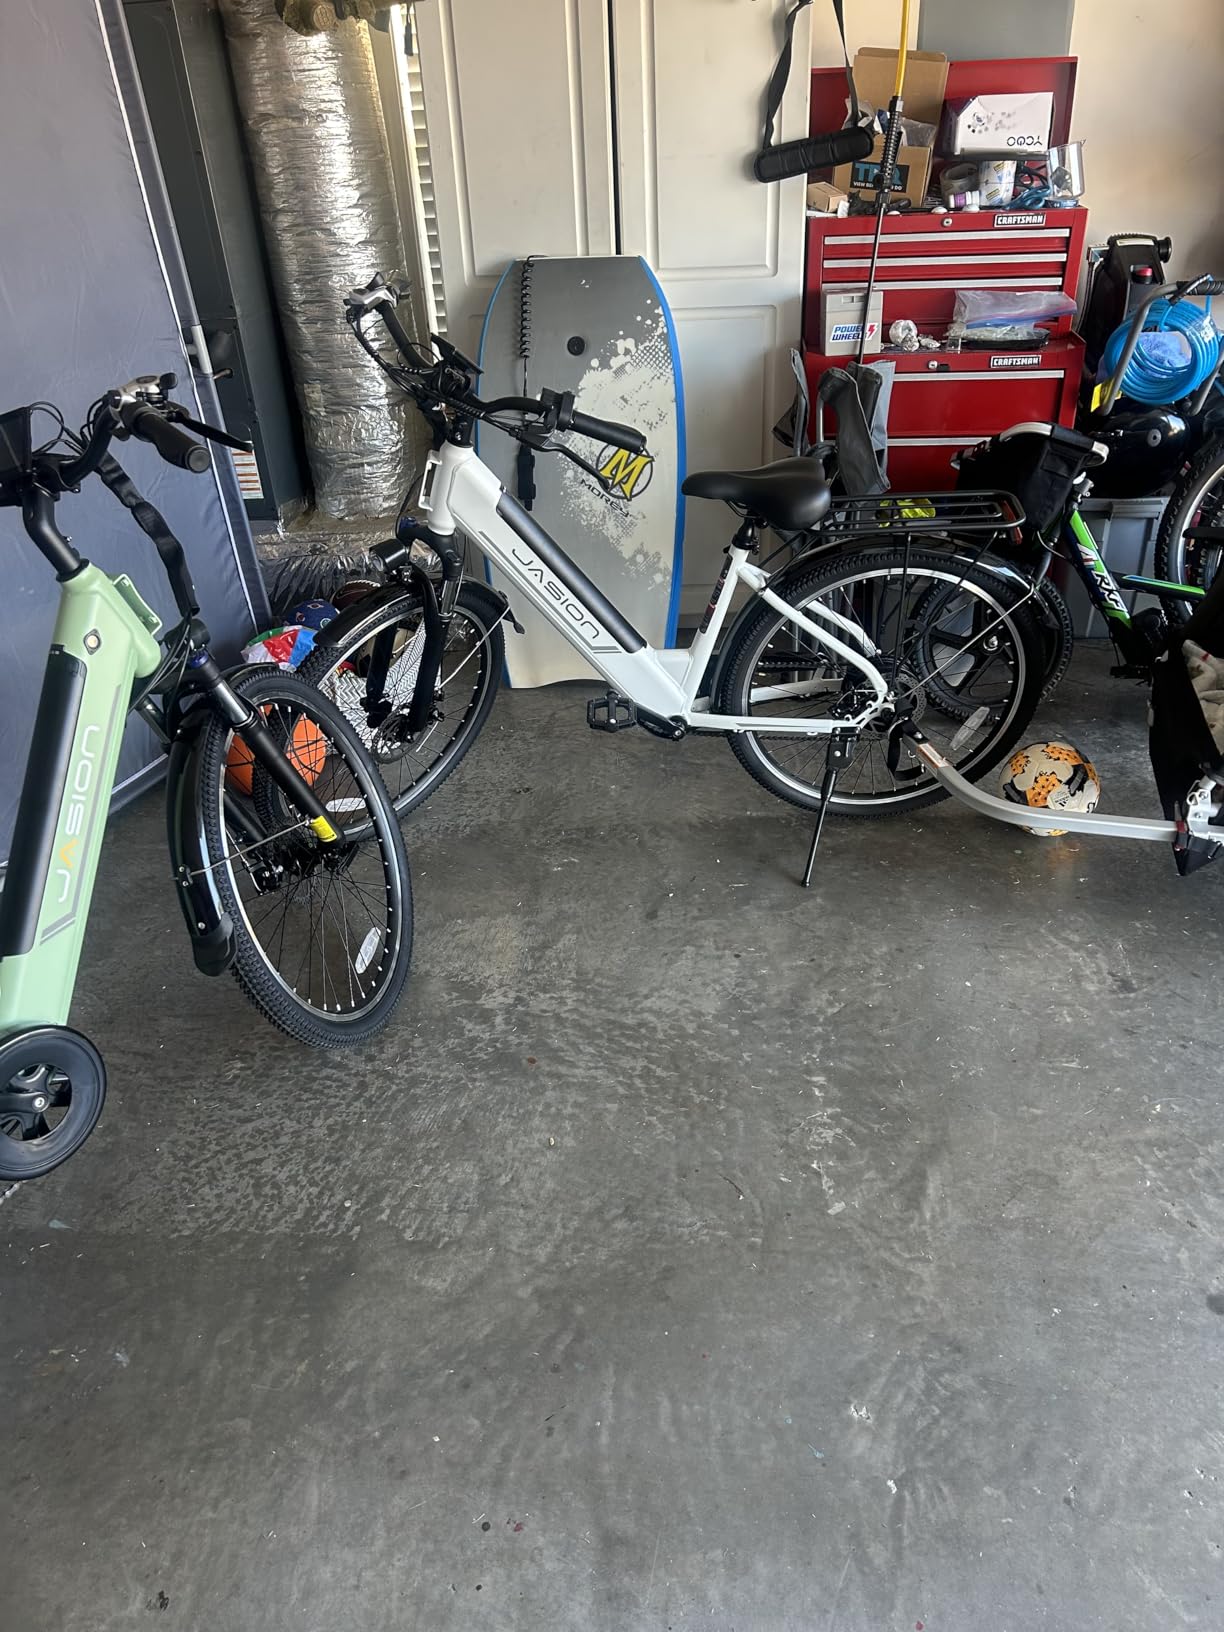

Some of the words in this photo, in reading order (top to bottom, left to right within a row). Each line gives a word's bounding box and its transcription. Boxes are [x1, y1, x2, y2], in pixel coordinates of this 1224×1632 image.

[997, 215, 1043, 225] CRAFTSMAN
[834, 325, 864, 333] POWE
[831, 332, 864, 341] WHEEL
[993, 357, 1039, 366] CRAFTSMAN
[512, 548, 600, 639] JASION
[57, 724, 100, 903] JASION
